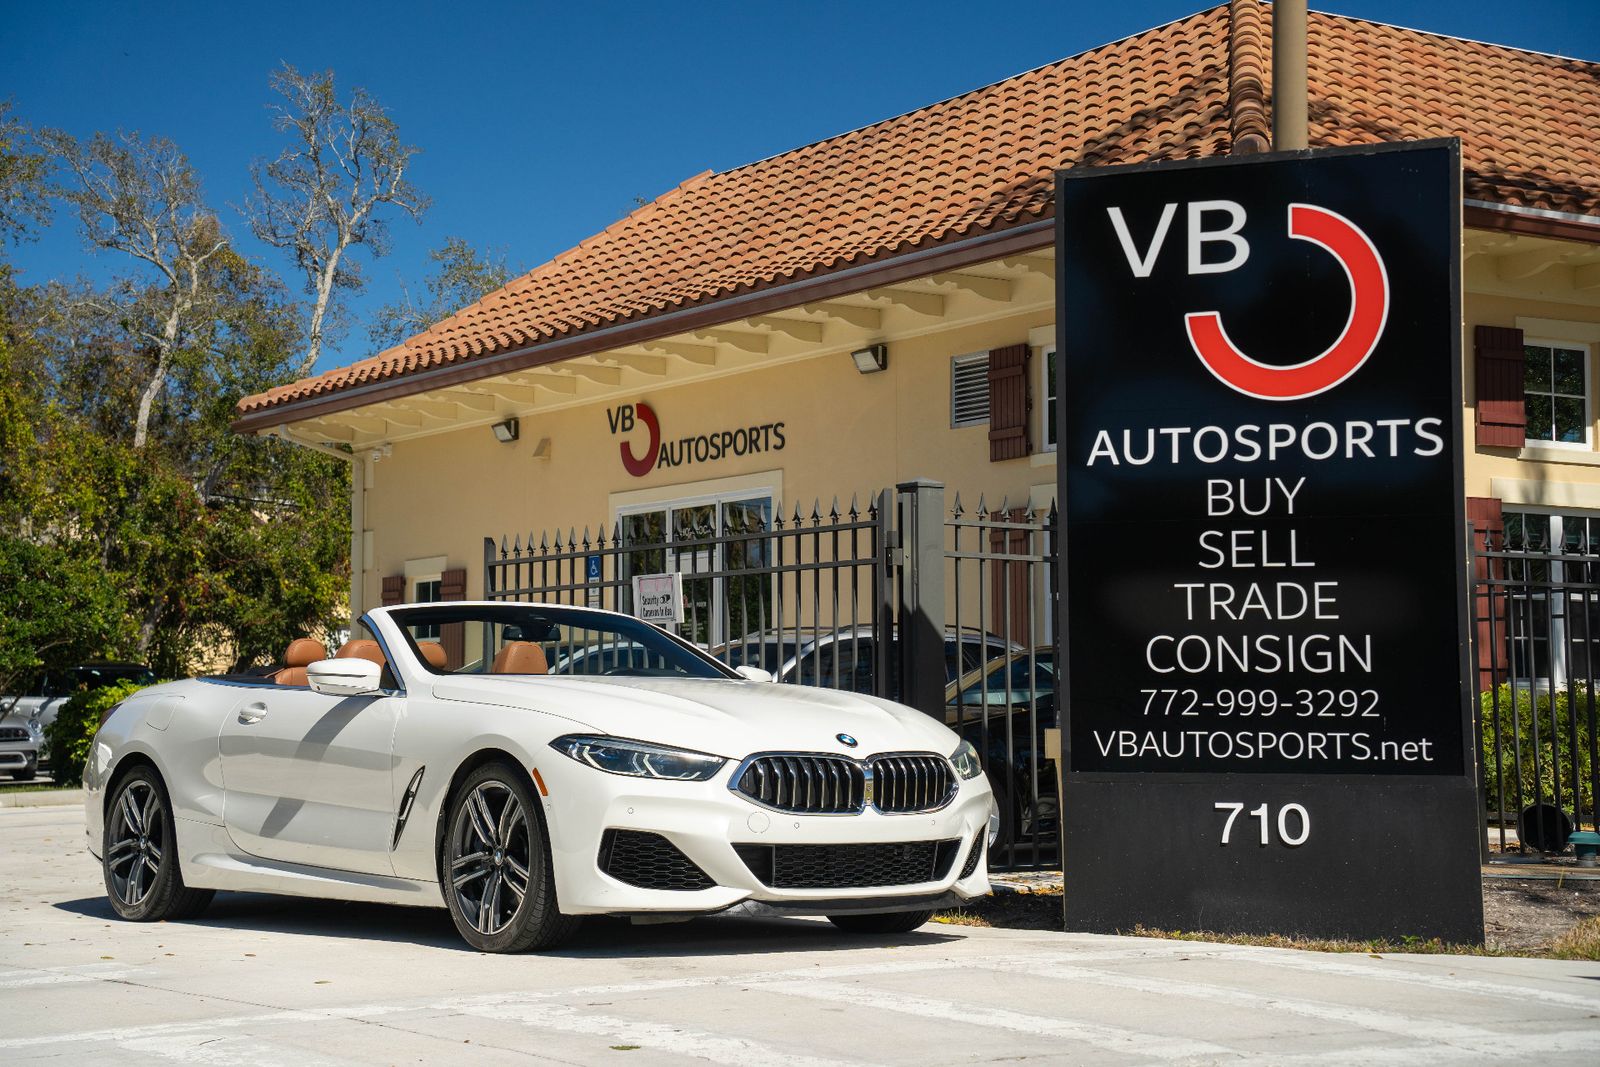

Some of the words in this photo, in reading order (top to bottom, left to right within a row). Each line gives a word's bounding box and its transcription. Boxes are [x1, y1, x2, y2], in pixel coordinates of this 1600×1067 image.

[1107, 200, 1250, 277] VB
[606, 404, 635, 434] VB
[656, 422, 786, 469] AUTOSPORTS
[1087, 418, 1443, 466] AUTOSPORTS
[1207, 477, 1306, 516] BUY
[1198, 530, 1316, 569] SELL
[1174, 582, 1340, 620] TRADE
[1146, 635, 1371, 673] CONSIGN
[1141, 689, 1380, 717] 772-999-3292
[1094, 731, 1434, 761] VBAUTOSPORTS.net
[1214, 802, 1311, 846] 710
